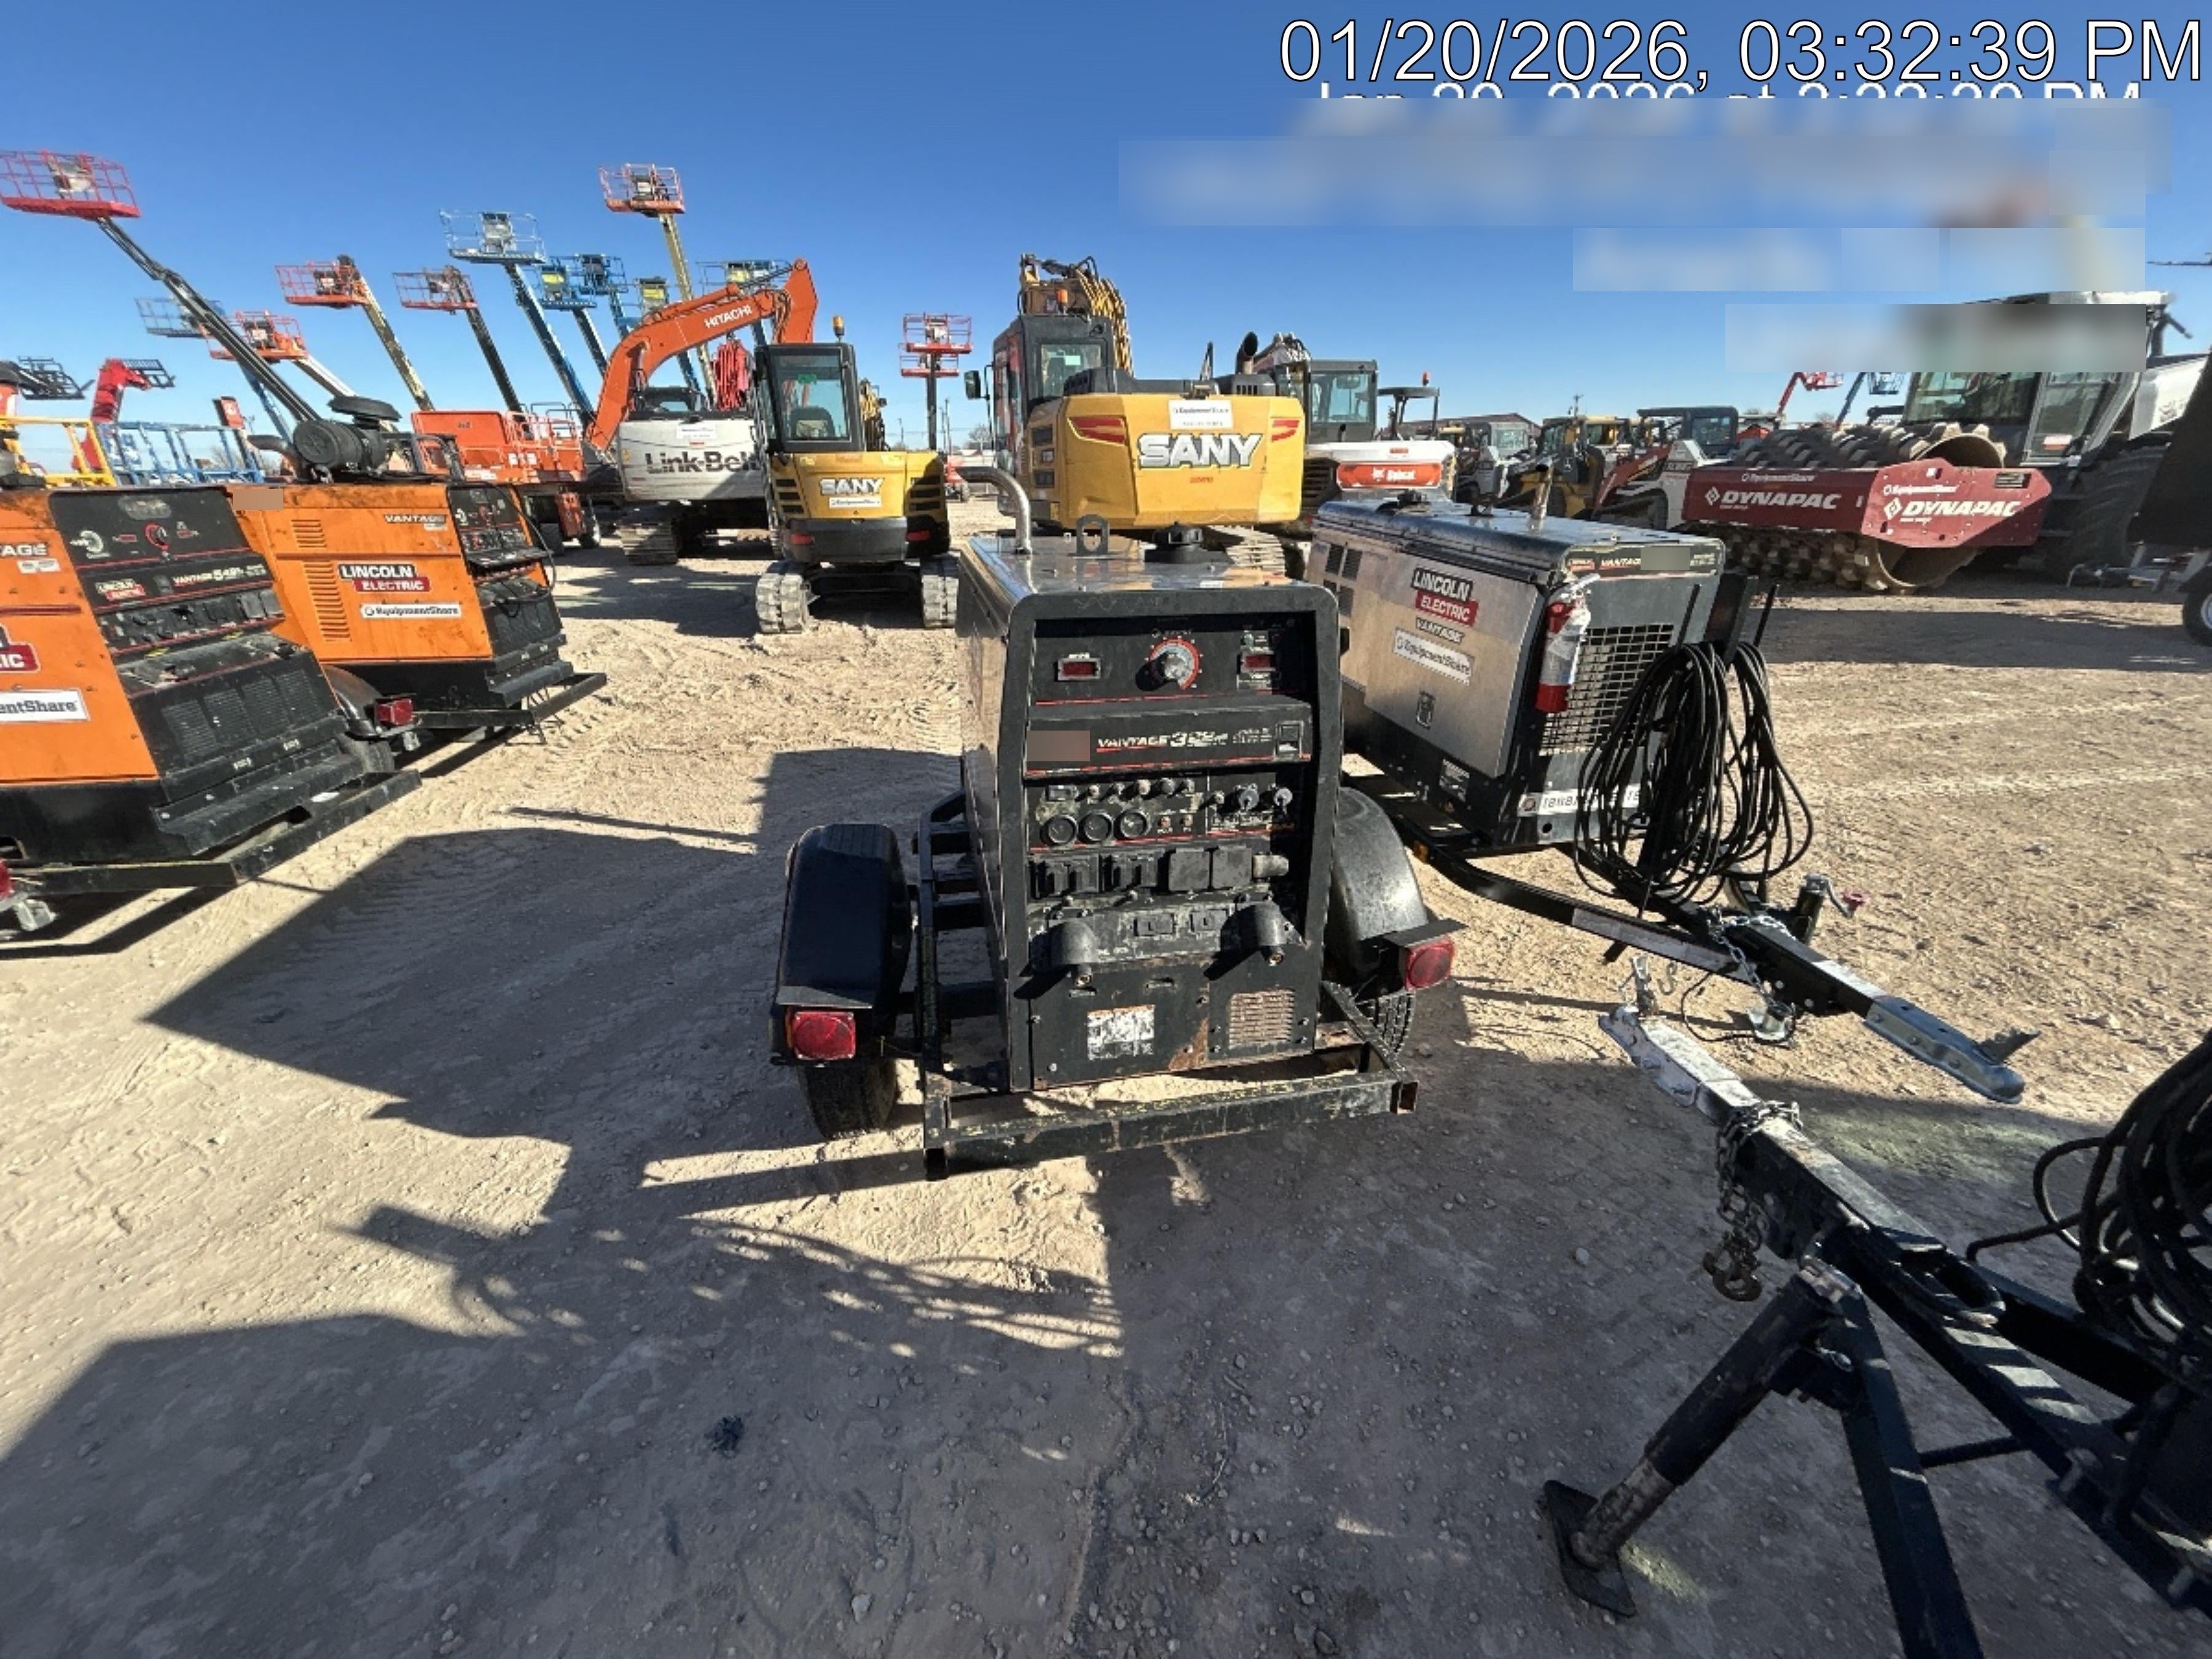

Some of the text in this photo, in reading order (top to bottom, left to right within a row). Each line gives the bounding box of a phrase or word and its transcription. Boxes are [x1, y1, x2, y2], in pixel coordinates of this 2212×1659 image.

[704, 304, 753, 329] HITACHI
[1138, 433, 1263, 469] SANY
[820, 477, 885, 496] SANY
[1721, 490, 1842, 509] DYNAPAC
[1902, 501, 2022, 517] DYNAPAC
[340, 565, 414, 578] LINCOLN
[361, 581, 425, 590] ELECTRIC
[1414, 571, 1470, 602] LINCOLN
[1421, 595, 1470, 621] ELECTRIC
